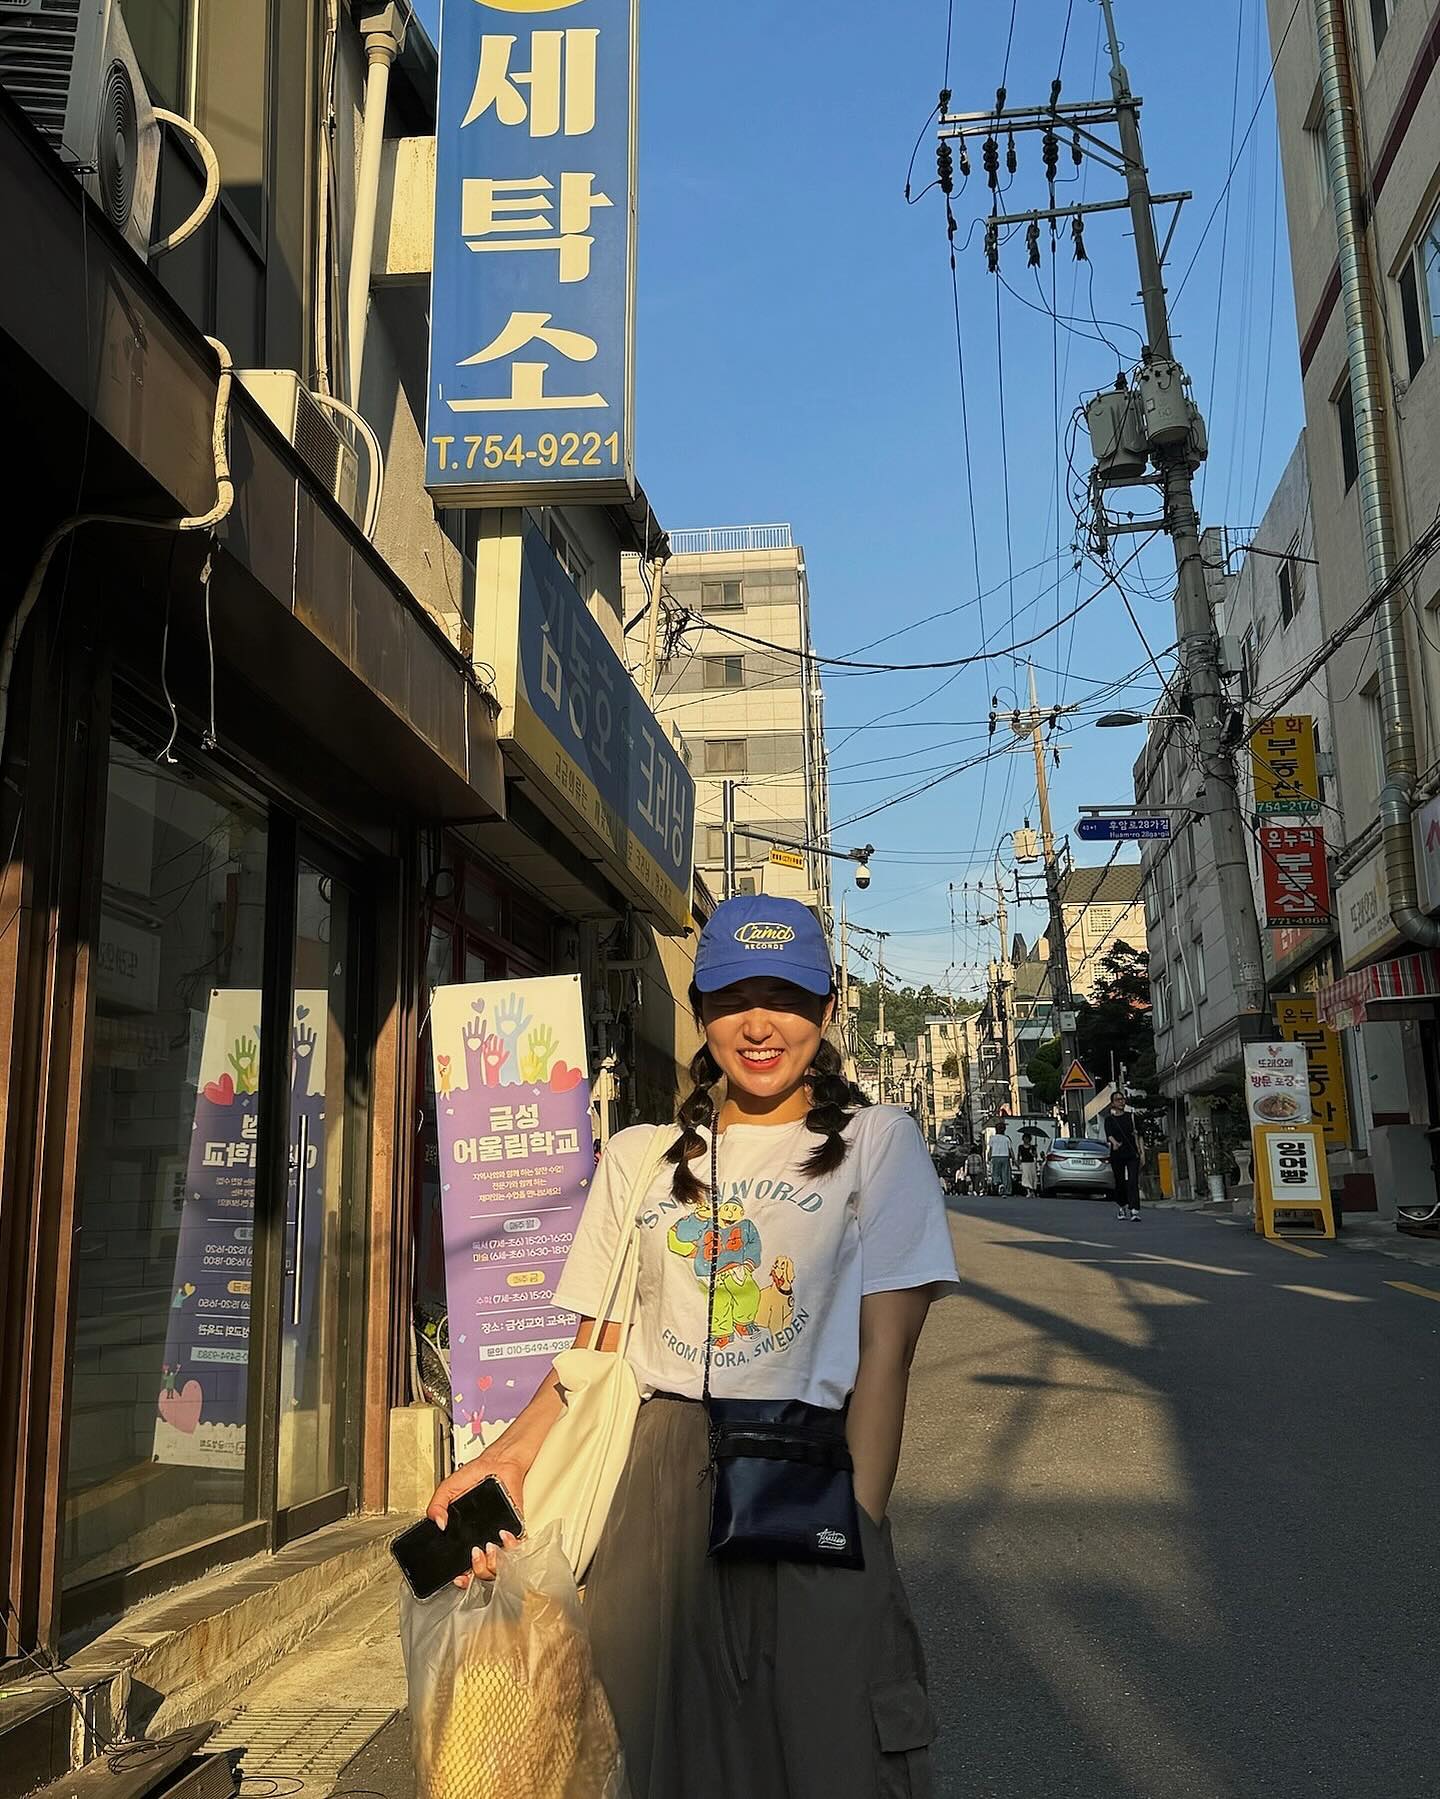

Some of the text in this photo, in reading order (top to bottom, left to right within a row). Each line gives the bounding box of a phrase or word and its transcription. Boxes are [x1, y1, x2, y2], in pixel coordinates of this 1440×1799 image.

[445, 28, 614, 413] 세탁소
[432, 431, 619, 470] T.754-9221
[1267, 738, 1303, 799] 부동산
[637, 724, 687, 868] 크리닝
[1257, 801, 1319, 814] 754-2176
[1108, 819, 1169, 831] 후암로28가길
[1273, 853, 1318, 912] 부동산
[1251, 1075, 1272, 1088] 방문
[1275, 1075, 1294, 1087] 포장
[489, 1103, 540, 1132] 금성
[453, 1128, 580, 1164] 어울림학교
[1277, 1142, 1308, 1183] 잉어빵
[505, 1316, 545, 1331] 금성교회
[546, 1313, 577, 1326] 교육관
[662, 1328, 698, 1363] FROM
[753, 1307, 810, 1358] SWEDEN
[487, 1340, 573, 1357] 문의 010-5494-938
